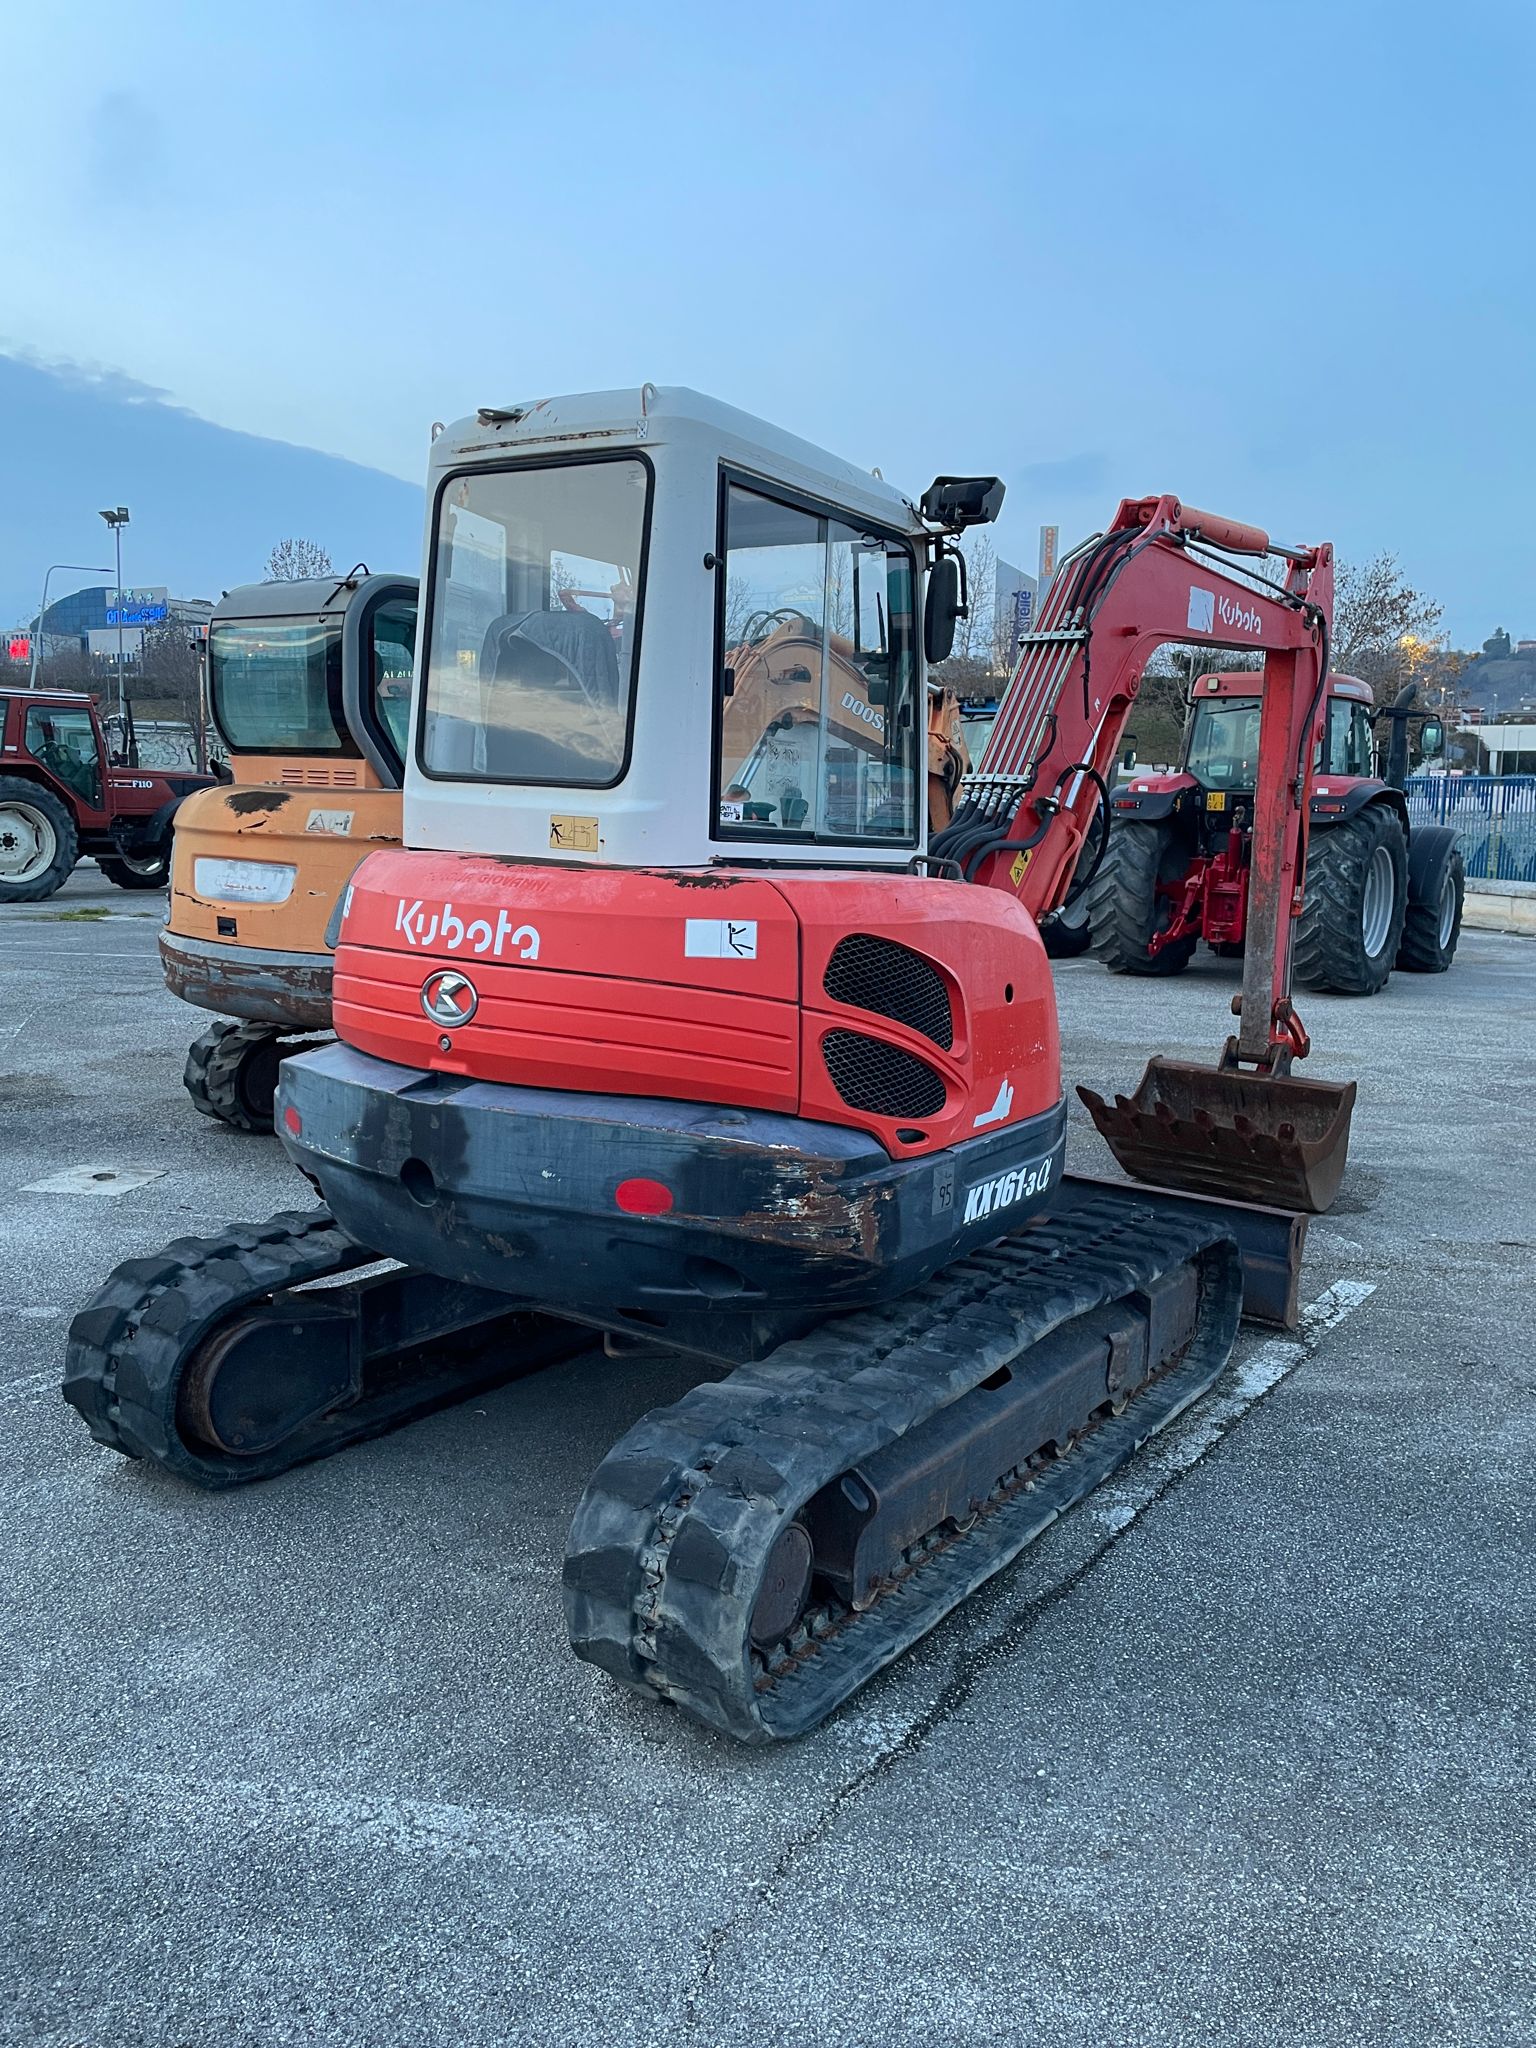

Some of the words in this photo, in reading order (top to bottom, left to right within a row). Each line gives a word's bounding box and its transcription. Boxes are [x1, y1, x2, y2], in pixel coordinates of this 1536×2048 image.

[1219, 595, 1262, 635] Kubota
[841, 692, 885, 733] DOOS
[132, 780, 153, 788] F110
[478, 873, 550, 892] GIOVANNI
[395, 899, 541, 960] Kubota
[940, 1183, 952, 1208] 95
